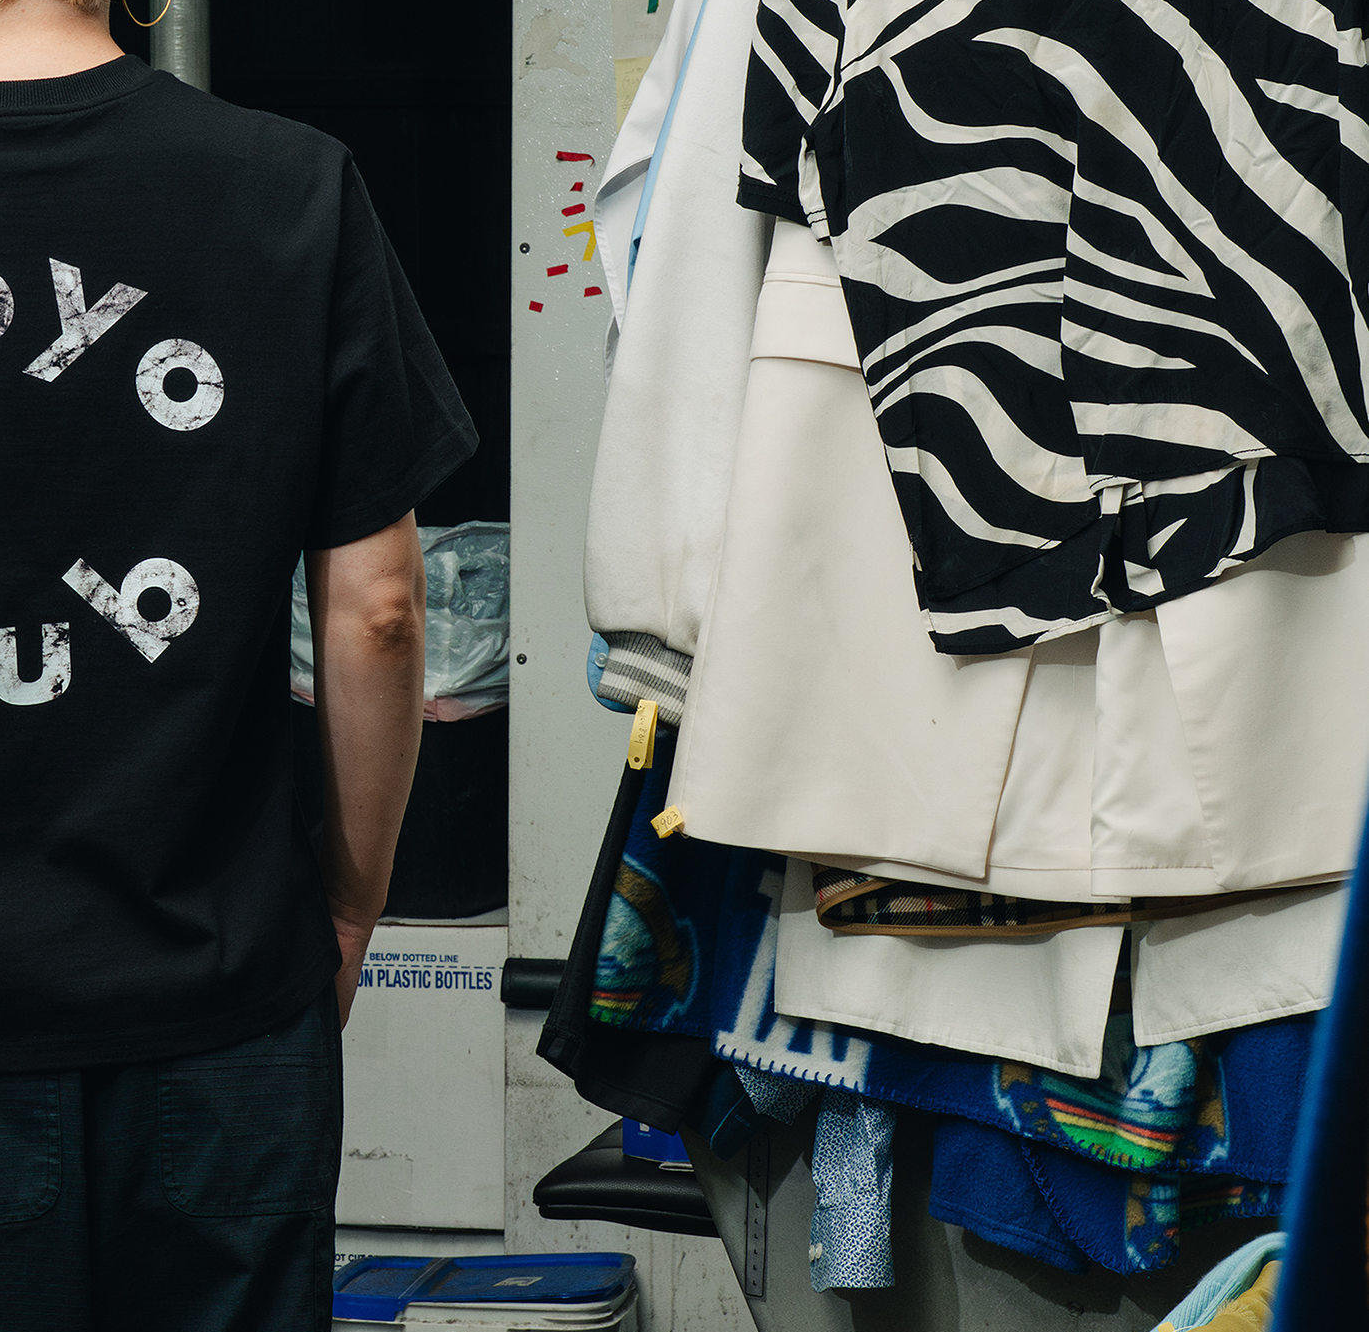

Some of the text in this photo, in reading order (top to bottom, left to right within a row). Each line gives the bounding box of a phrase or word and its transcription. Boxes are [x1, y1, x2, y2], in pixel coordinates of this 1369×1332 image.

[369, 952, 459, 963] BELOW DOTTED LINE
[377, 969, 431, 988] PLASTIC
[435, 970, 493, 990] BOTTLES
